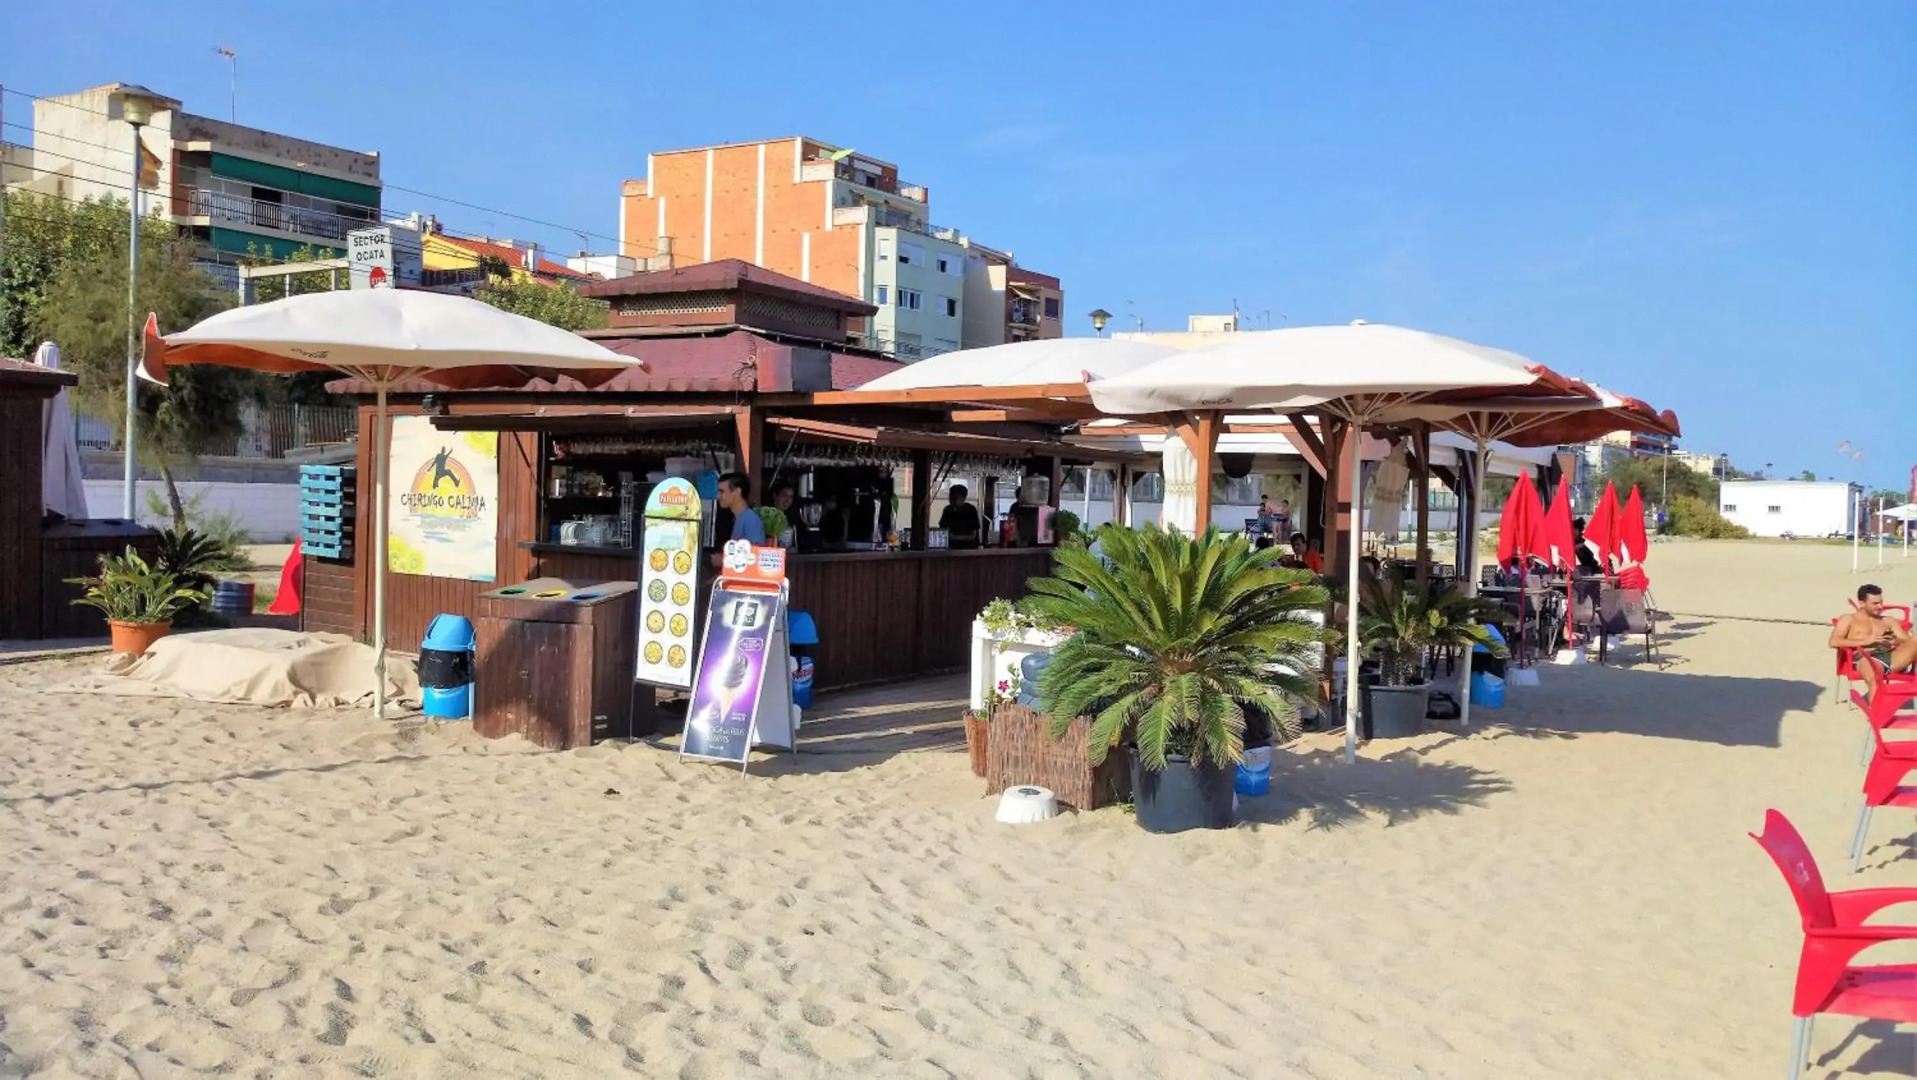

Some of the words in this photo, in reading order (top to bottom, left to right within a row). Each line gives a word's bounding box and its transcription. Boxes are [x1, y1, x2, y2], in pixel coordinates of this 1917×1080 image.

[353, 234, 386, 247] SECTOR
[356, 249, 385, 262] OCATA
[400, 492, 445, 509] CHIRINGO
[447, 494, 486, 512] CALIMA
